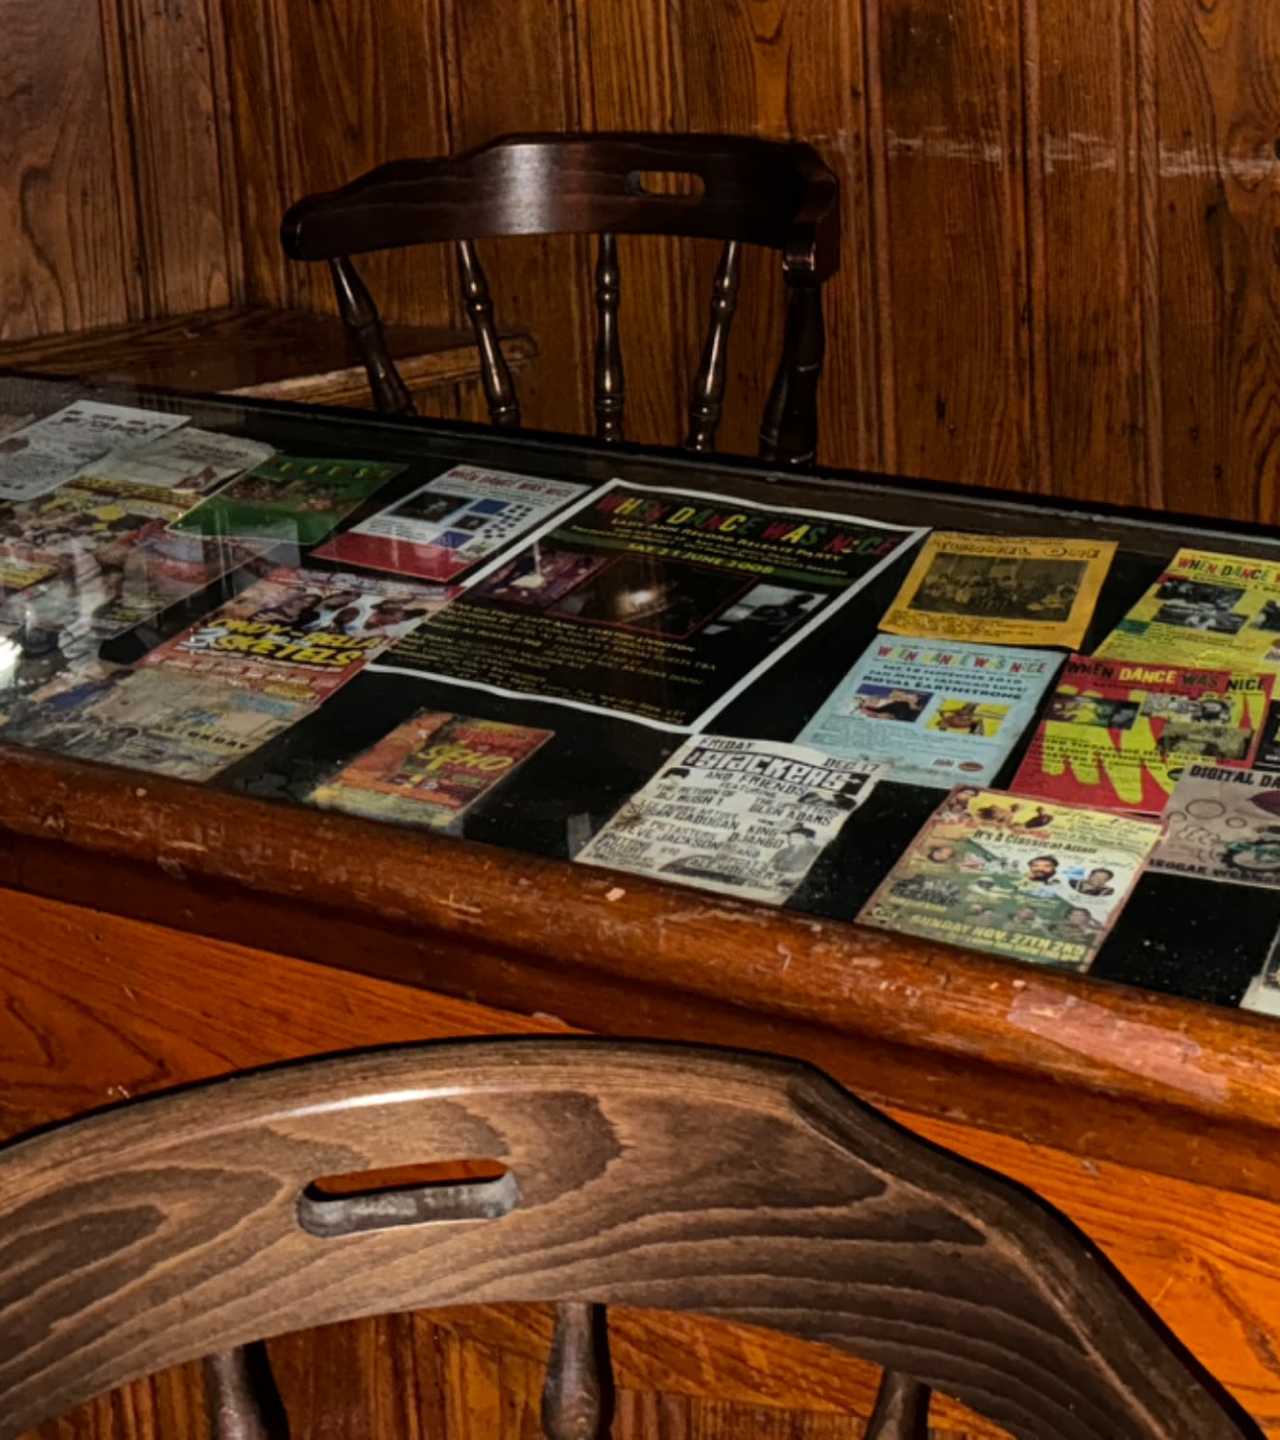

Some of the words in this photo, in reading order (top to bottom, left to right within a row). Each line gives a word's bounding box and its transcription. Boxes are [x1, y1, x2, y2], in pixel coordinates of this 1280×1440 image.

[1178, 557, 1217, 575] WHEN
[1221, 565, 1269, 581] DANCE
[1069, 662, 1114, 678] WHEN
[1119, 667, 1178, 684] DANCE
[1181, 673, 1219, 688] WAS
[1226, 678, 1266, 692] NICE
[699, 738, 755, 751] FRIDAY
[705, 770, 734, 781] AND
[737, 773, 806, 796] FRIENDS
[1188, 763, 1255, 786] DIGITAL
